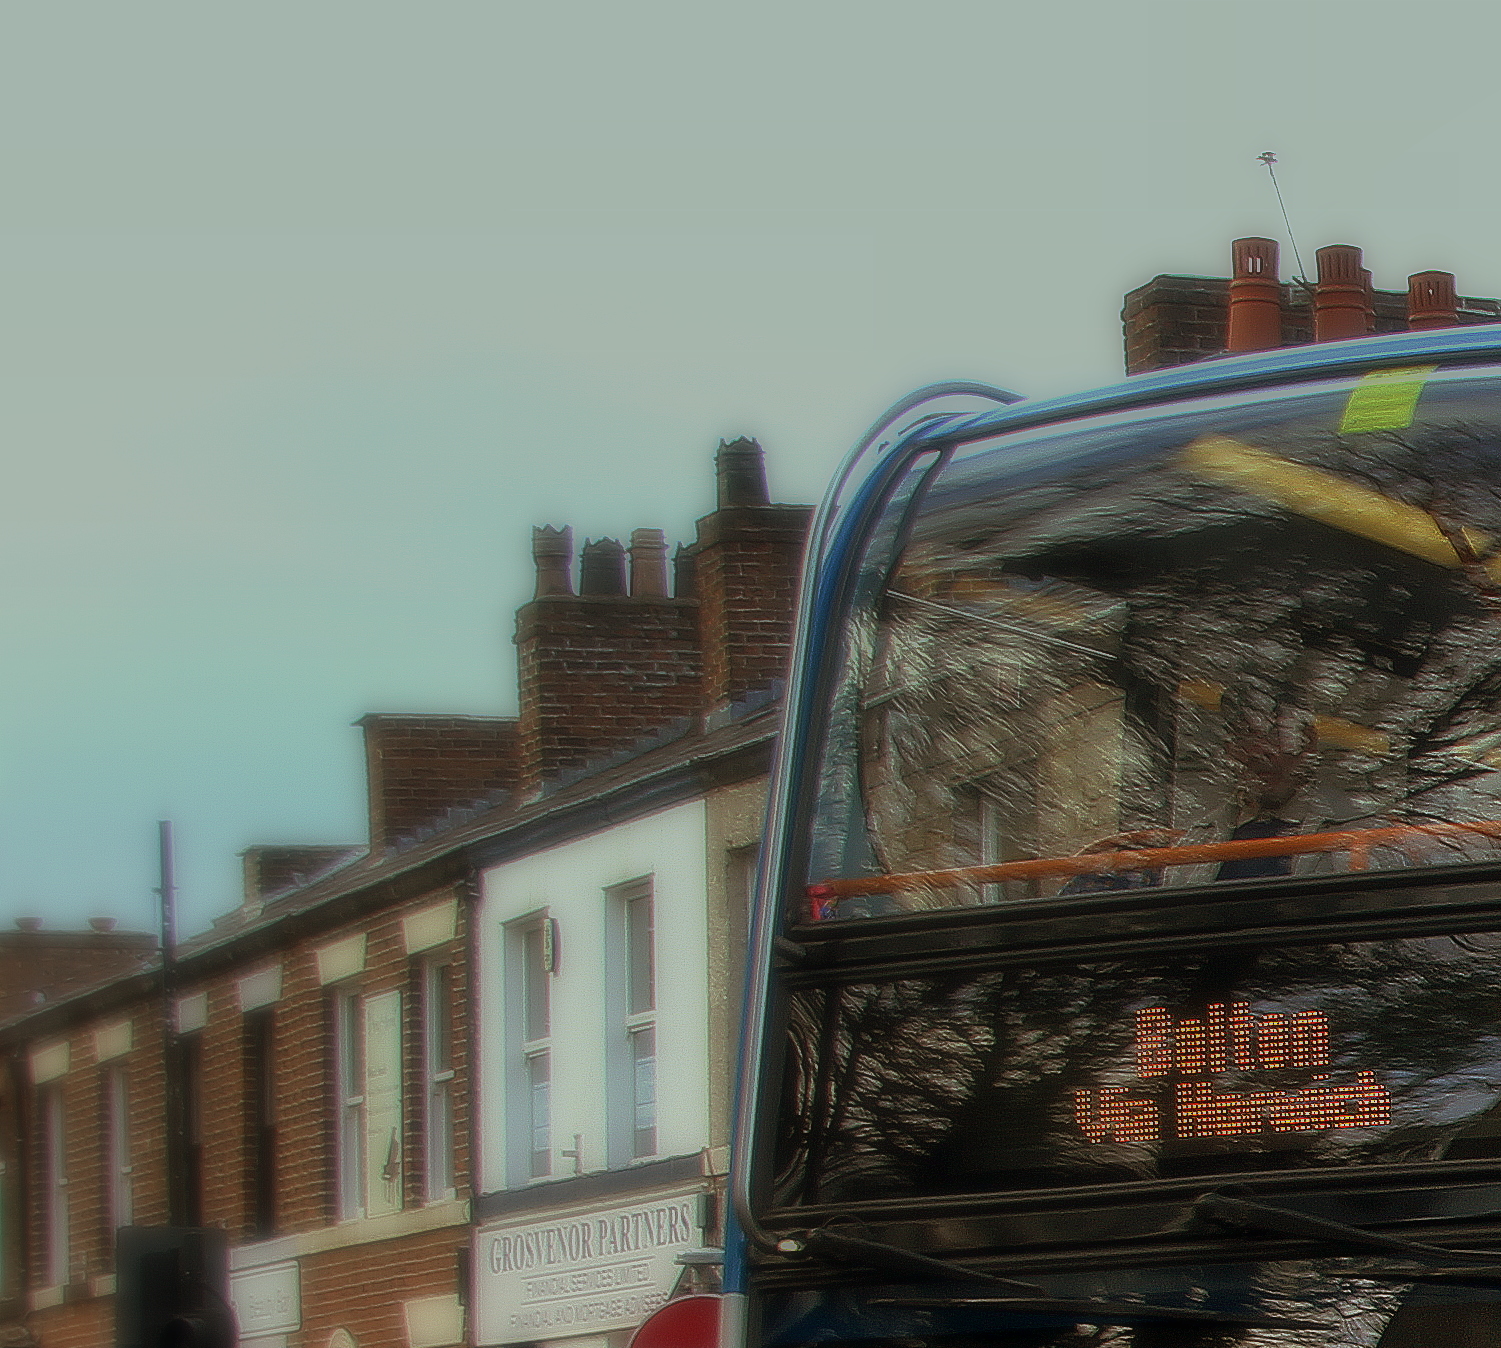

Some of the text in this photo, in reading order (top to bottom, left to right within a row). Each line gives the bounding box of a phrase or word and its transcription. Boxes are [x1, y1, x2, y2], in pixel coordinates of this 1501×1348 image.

[1135, 1000, 1330, 1078] Bolton
[1176, 1070, 1392, 1140] Horwich
[490, 1203, 691, 1274] GROSVENOR PARTNERS
